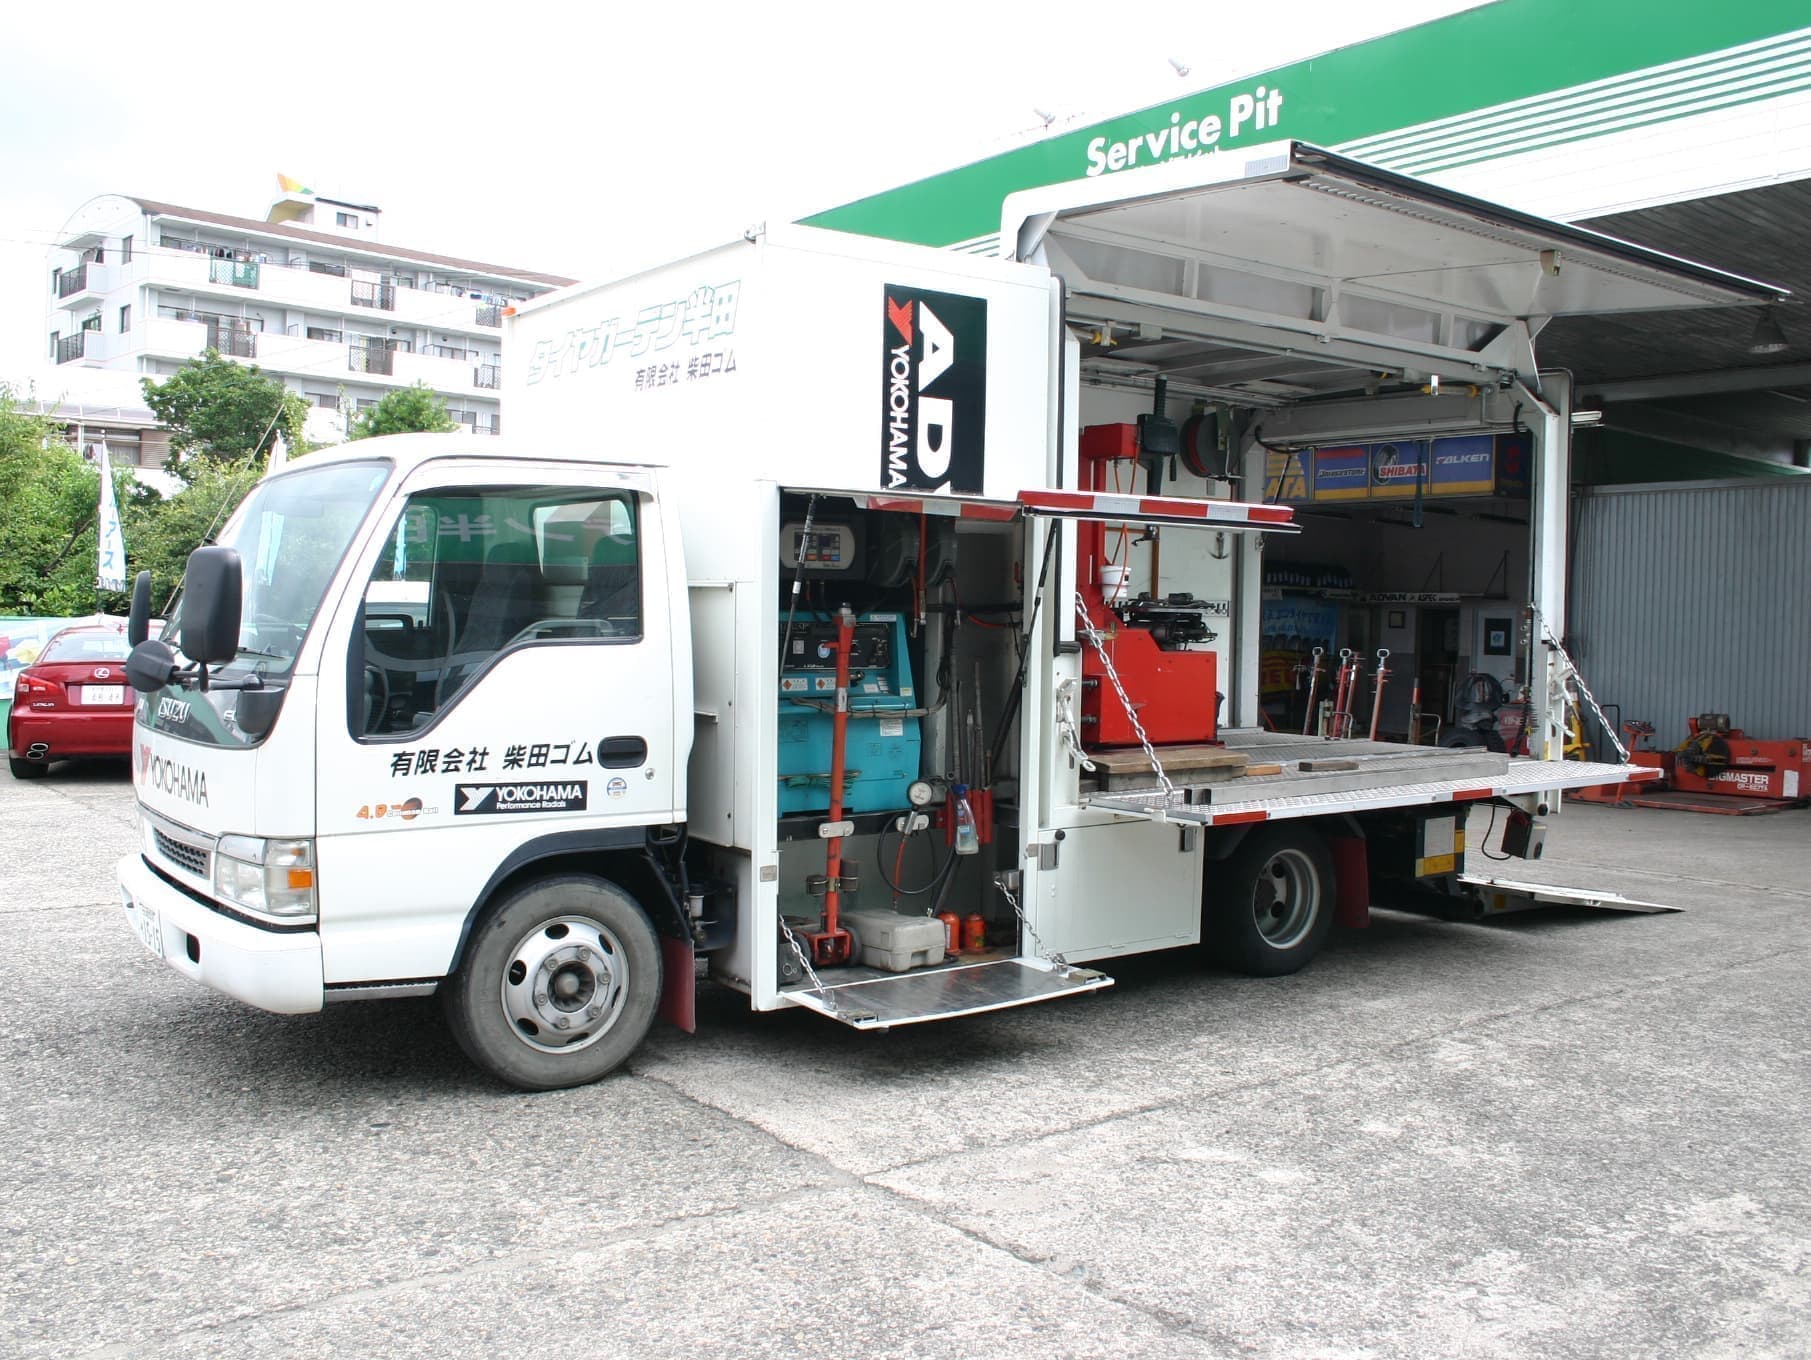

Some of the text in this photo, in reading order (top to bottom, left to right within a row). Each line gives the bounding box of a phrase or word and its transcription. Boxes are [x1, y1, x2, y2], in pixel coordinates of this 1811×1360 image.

[1086, 86, 1284, 177] Service Pit
[888, 344, 911, 488] YOKOHAMA
[917, 300, 954, 494] AD
[151, 755, 209, 809] YOKOHAMA
[390, 739, 594, 778] 有限会社 柴田ゴム
[495, 784, 583, 802] YOKOHAMA
